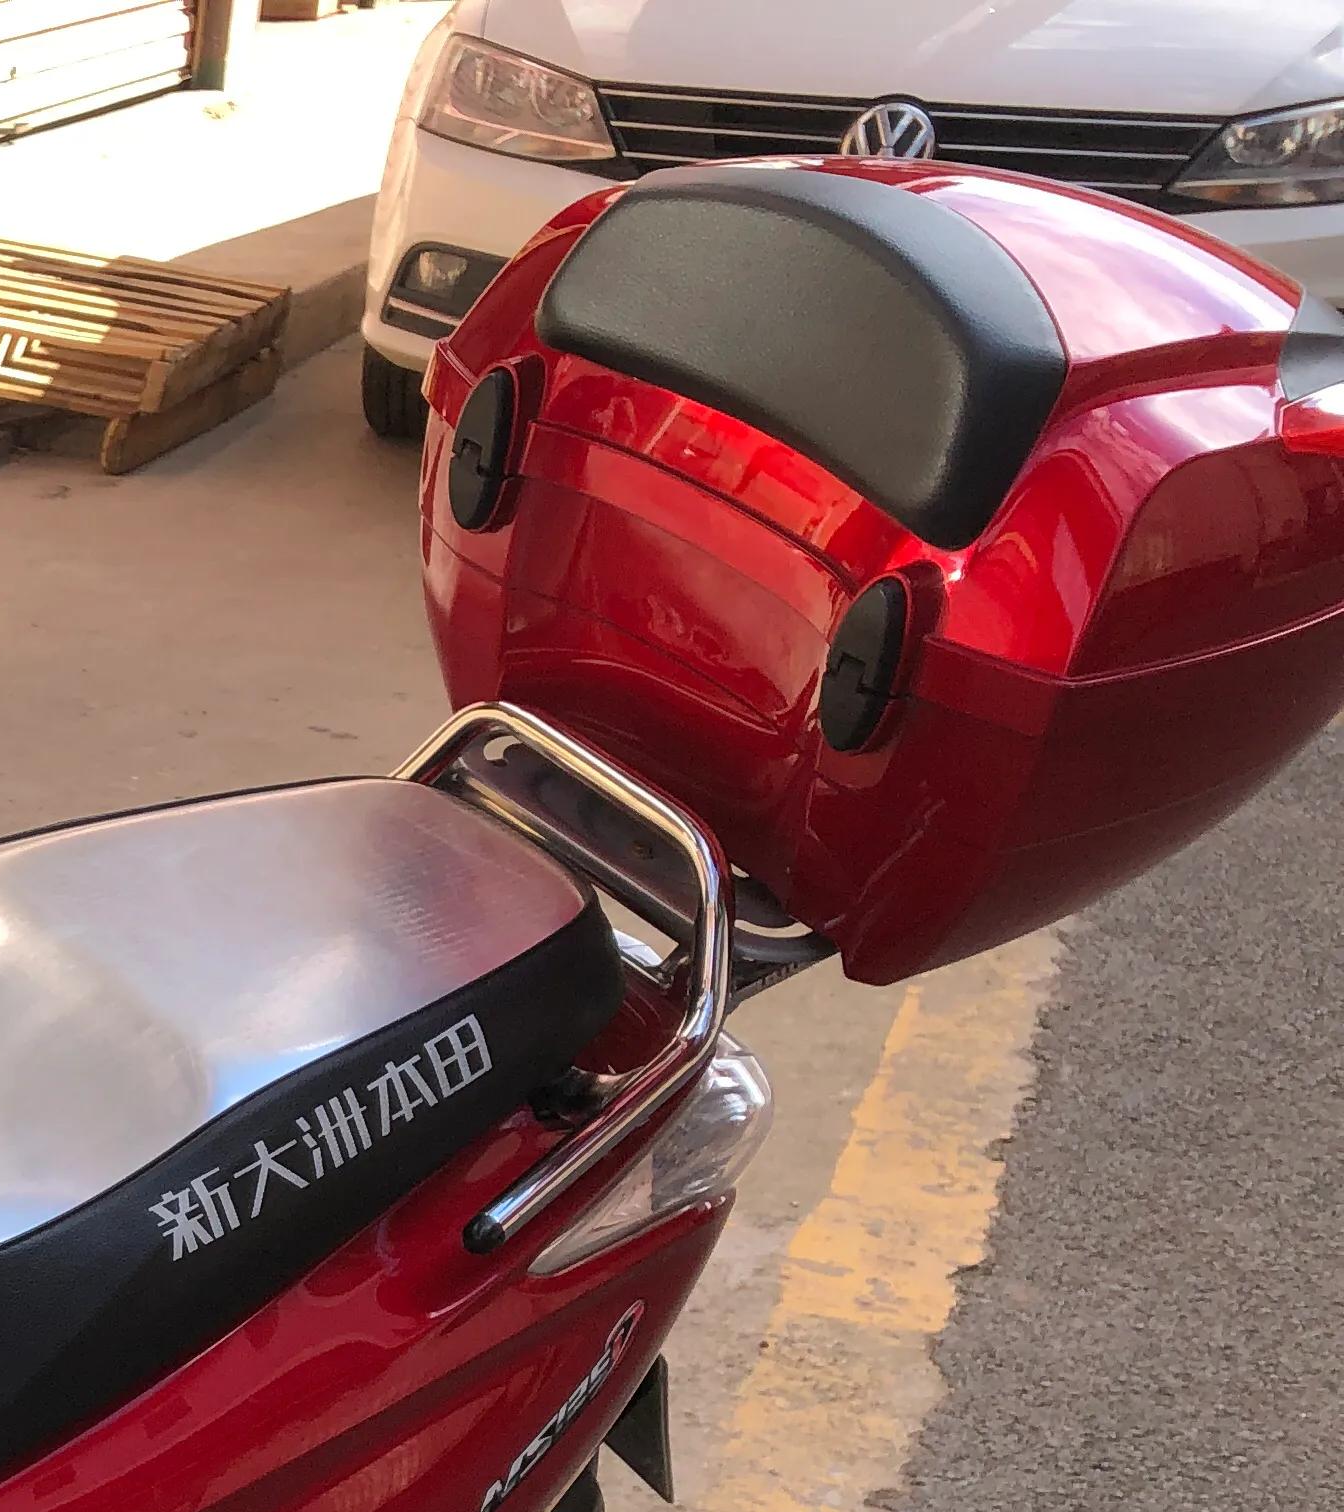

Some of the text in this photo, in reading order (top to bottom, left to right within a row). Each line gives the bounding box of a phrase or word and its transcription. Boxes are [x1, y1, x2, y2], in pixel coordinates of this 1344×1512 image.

[147, 1013, 492, 1262] 新大洲本田
